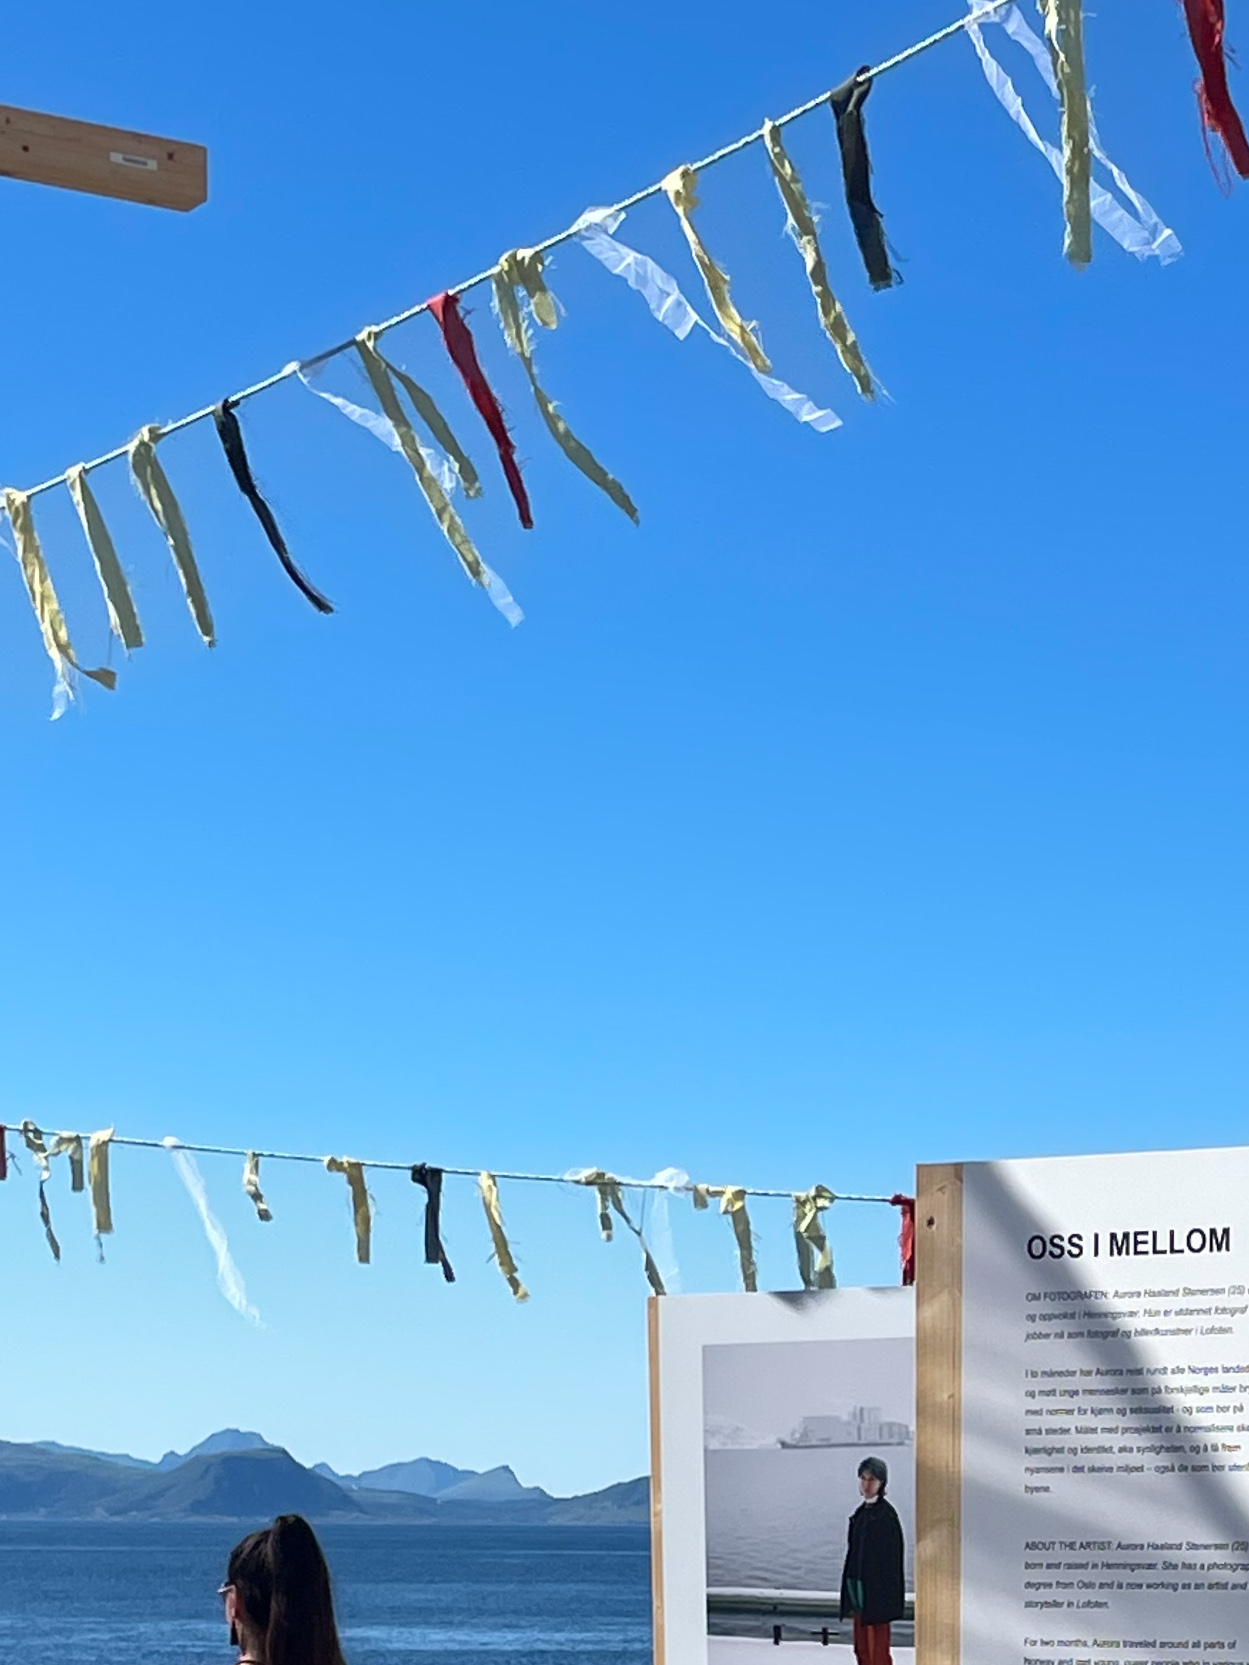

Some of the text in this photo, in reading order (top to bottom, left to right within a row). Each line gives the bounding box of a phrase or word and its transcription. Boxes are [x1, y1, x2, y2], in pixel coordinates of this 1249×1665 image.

[1027, 1227, 1231, 1259] OSS I MELLOM
